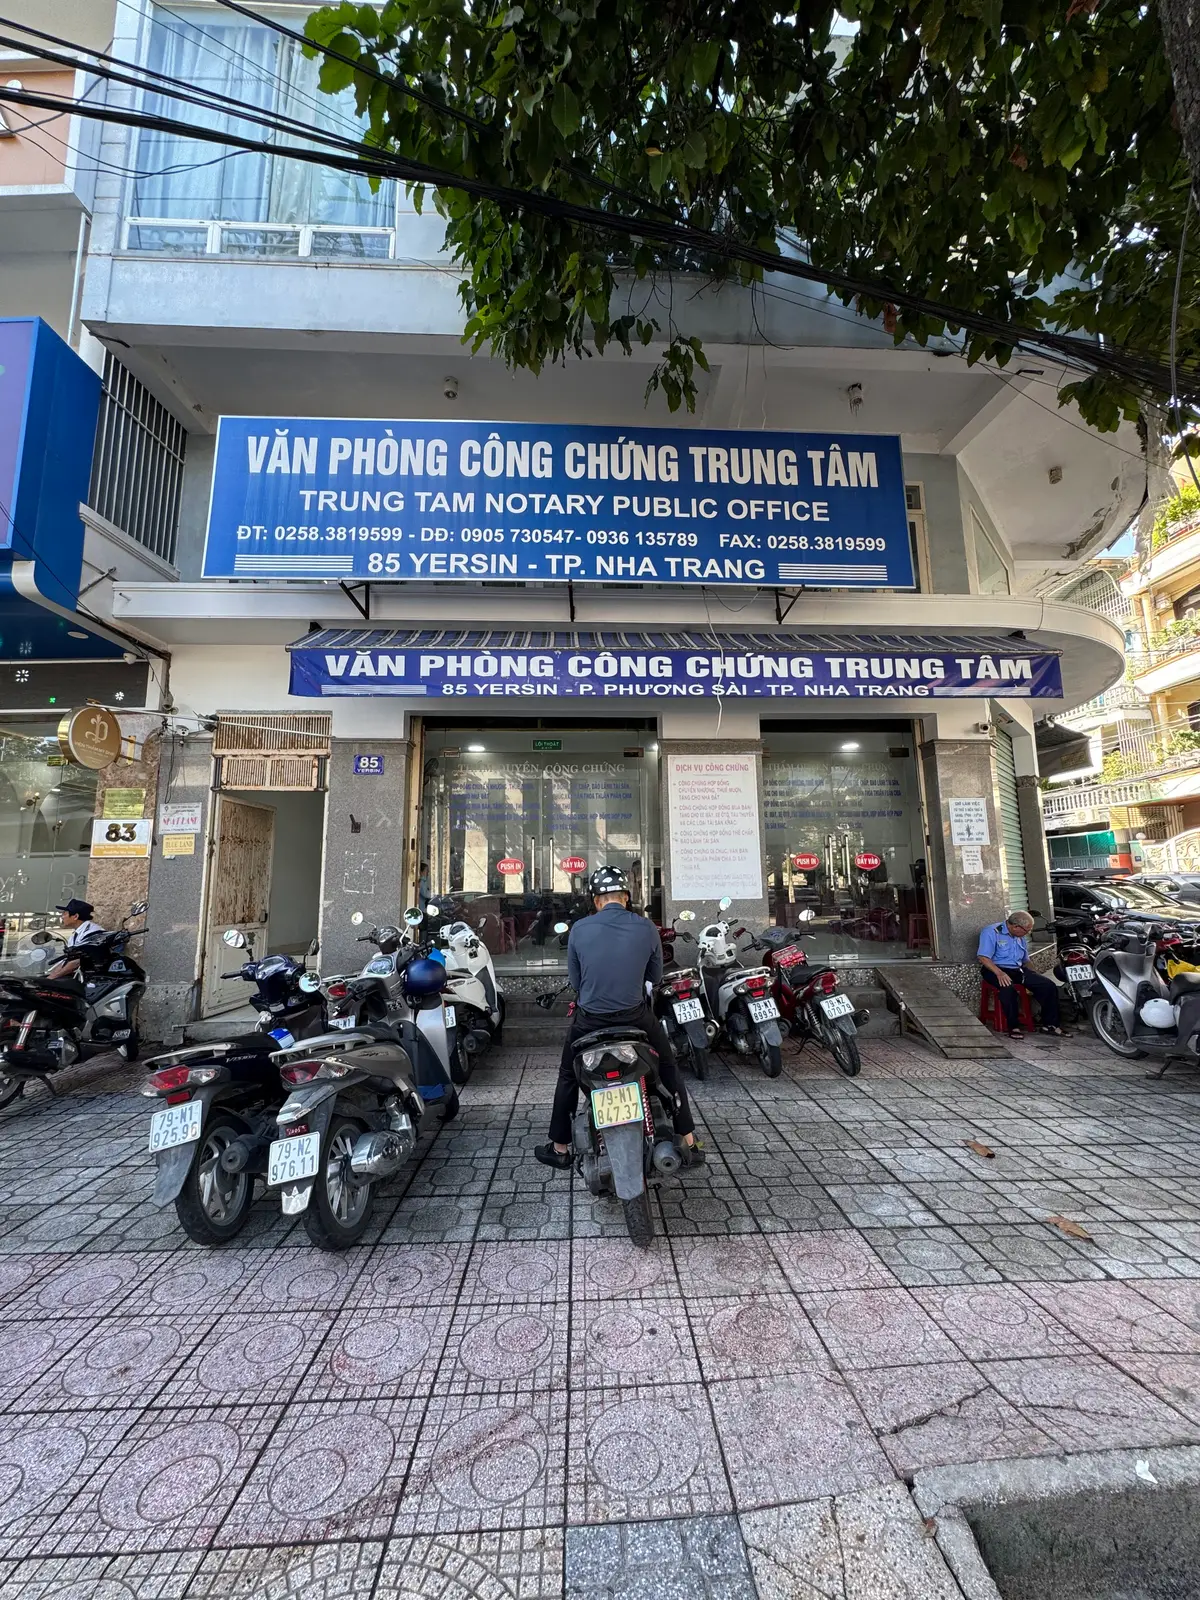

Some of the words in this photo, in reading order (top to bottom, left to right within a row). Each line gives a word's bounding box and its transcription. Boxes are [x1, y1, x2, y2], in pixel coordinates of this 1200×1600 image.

[248, 428, 318, 474] VĂN
[329, 429, 447, 476] PHÒNG
[460, 432, 552, 479] CÔNG
[565, 436, 678, 481] CHỨNG
[689, 447, 798, 486] TRUNG
[808, 443, 879, 488] TÂM
[300, 490, 404, 512] TRUNG
[415, 491, 474, 513] TAM
[486, 493, 604, 515] NOTARY
[614, 495, 717, 518] PUBLIC
[728, 499, 829, 522] OFFICE
[236, 526, 268, 540] ĐT:
[275, 526, 402, 542] 0258.3819599
[420, 528, 454, 542] DĐ:
[461, 528, 504, 543] 0905
[586, 531, 629, 545] 0936
[635, 532, 698, 547] 135789
[719, 534, 761, 549] FAX:
[767, 535, 886, 551] 0258.3819599
[368, 552, 400, 573] 85
[409, 553, 518, 574] YERSIN
[546, 554, 586, 575] TP.
[597, 555, 658, 576] NHA
[665, 557, 765, 579] TRANG
[325, 650, 405, 677] VĂN
[420, 650, 554, 677] PHÒNG
[567, 651, 672, 678] CÔNG
[687, 652, 814, 678] CHỨNG
[825, 657, 944, 679] TRUNG
[956, 654, 1033, 680] TÂM
[442, 683, 467, 695] 85
[474, 683, 558, 695] YERSIN
[580, 683, 597, 696] P.
[604, 683, 705, 696] PHƯƠNG
[711, 681, 747, 696] SÀI
[767, 684, 797, 696] TP.
[805, 684, 850, 696] NHA
[855, 685, 930, 697] TRANG
[360, 757, 378, 769] 85
[105, 823, 137, 842] 83
[500, 861, 514, 870] PUSH
[796, 857, 810, 865] PUSH
[677, 1000, 697, 1013] 79-N2
[752, 998, 772, 1013] 79-N1
[824, 996, 846, 1009] 79-N2
[599, 1086, 633, 1108] 79-N1
[159, 1105, 194, 1130] 79-N1
[597, 1101, 639, 1125] 847.37
[152, 1121, 198, 1149] 925.96
[277, 1137, 312, 1161] 79-N2
[271, 1155, 315, 1182] 976.11
